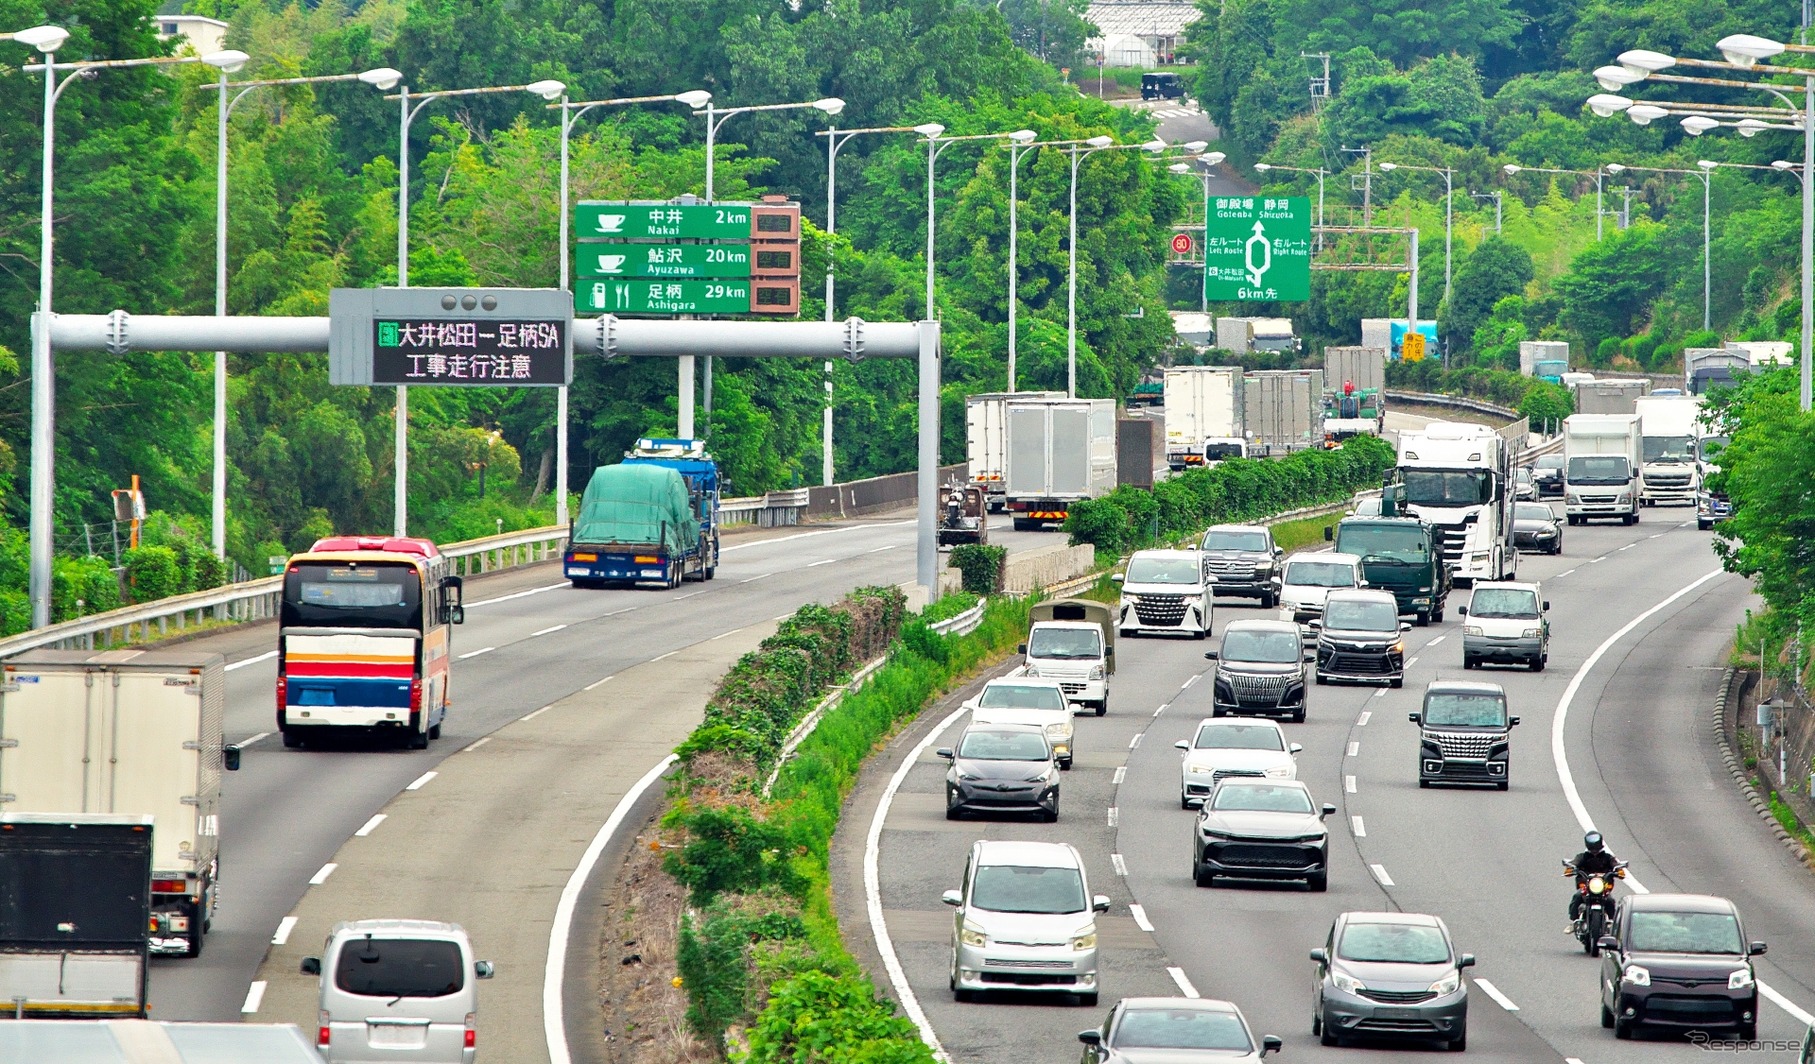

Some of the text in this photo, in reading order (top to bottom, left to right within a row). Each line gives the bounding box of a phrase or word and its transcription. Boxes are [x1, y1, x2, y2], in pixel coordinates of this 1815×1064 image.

[1216, 198, 1289, 211] 御殿場 静岡
[649, 209, 683, 225] 中井
[1217, 210, 1294, 219] Gotenba Shizuoka
[647, 225, 680, 235] Nakai
[1176, 239, 1186, 249] 80
[1209, 237, 1243, 246] 左ルート
[1273, 238, 1307, 248] 右ルート
[647, 248, 683, 263] 鮎沢
[1273, 248, 1289, 256] Right
[647, 264, 695, 275] Ayuzawa
[648, 284, 683, 299] 足柄
[647, 300, 696, 310] Ashigara
[405, 353, 532, 379] 工事走行注意
